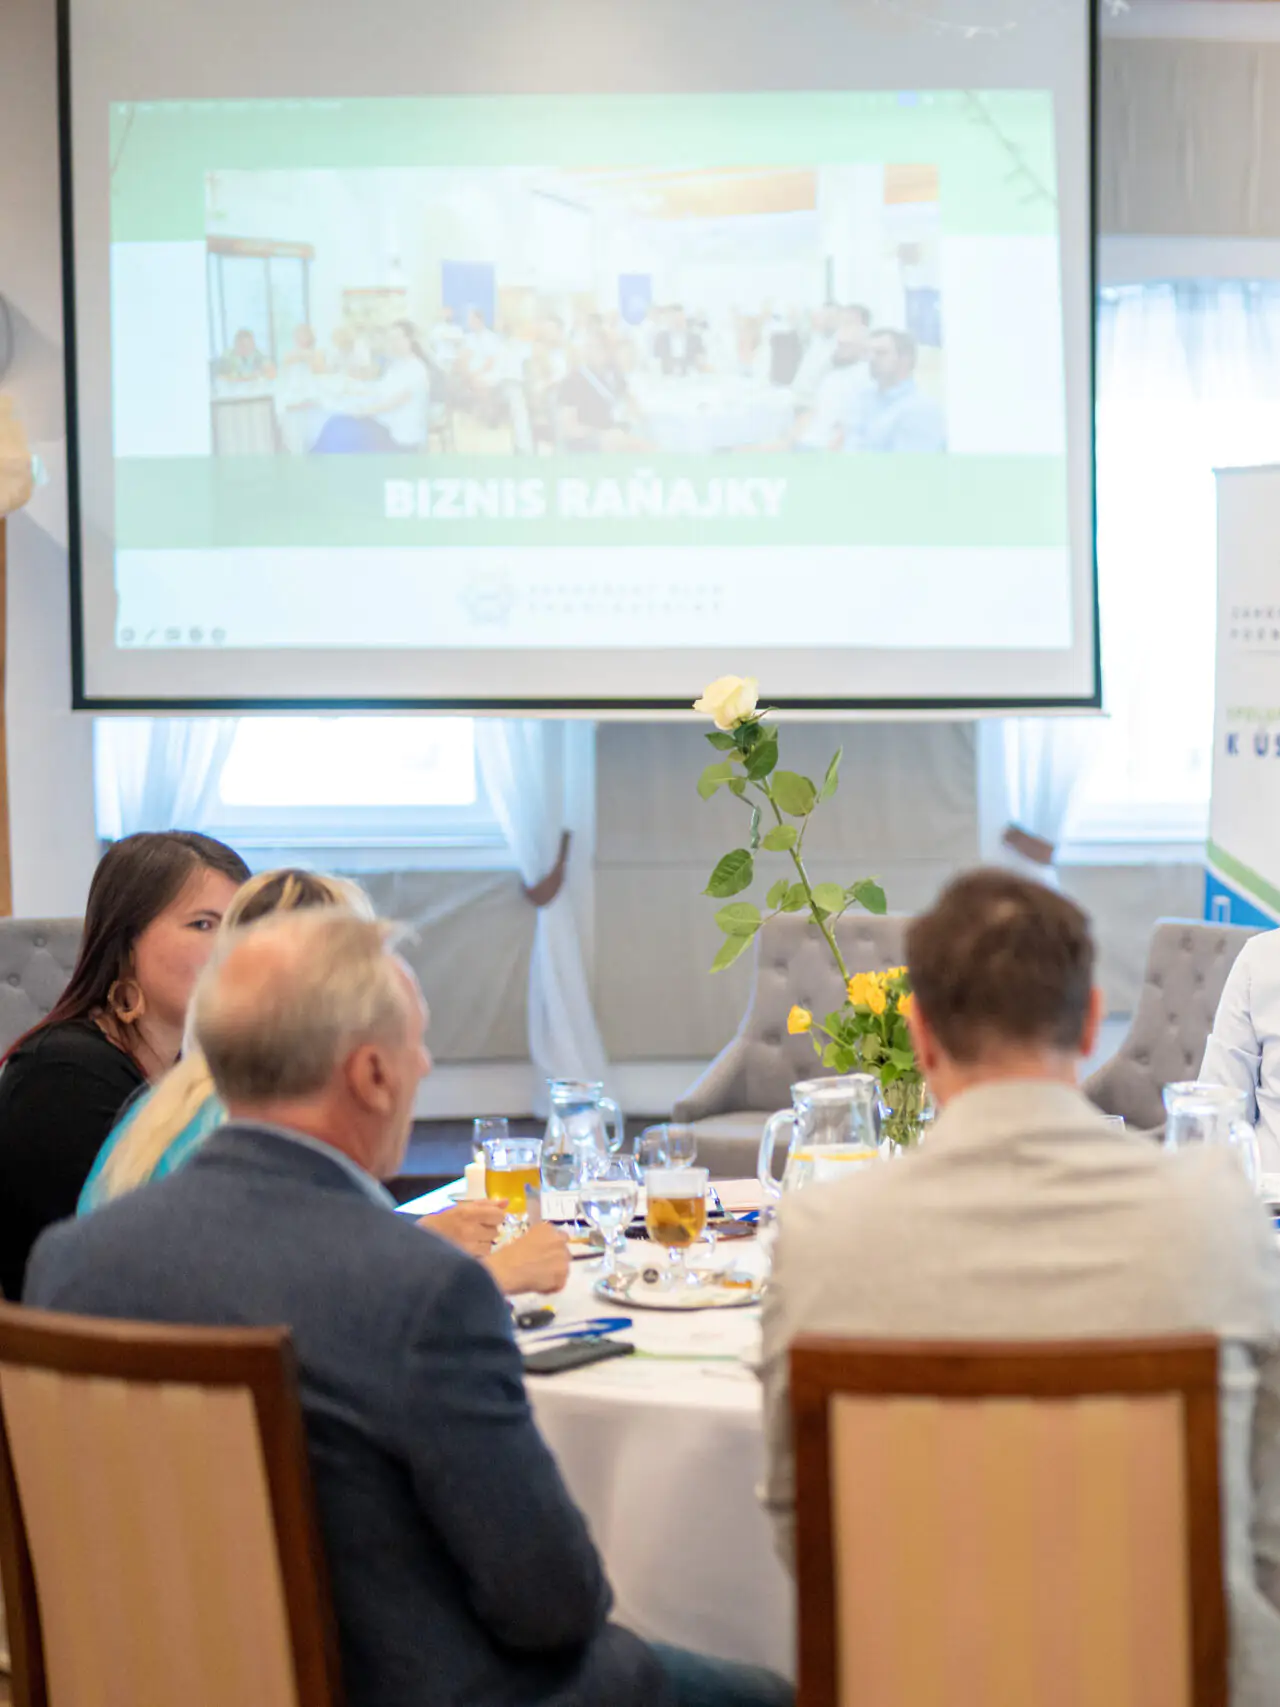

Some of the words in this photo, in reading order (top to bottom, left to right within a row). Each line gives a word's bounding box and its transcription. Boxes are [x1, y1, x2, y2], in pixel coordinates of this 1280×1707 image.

[384, 477, 547, 519] BIZNIS
[557, 466, 788, 519] RAŇAJKY
[1226, 732, 1239, 756] K
